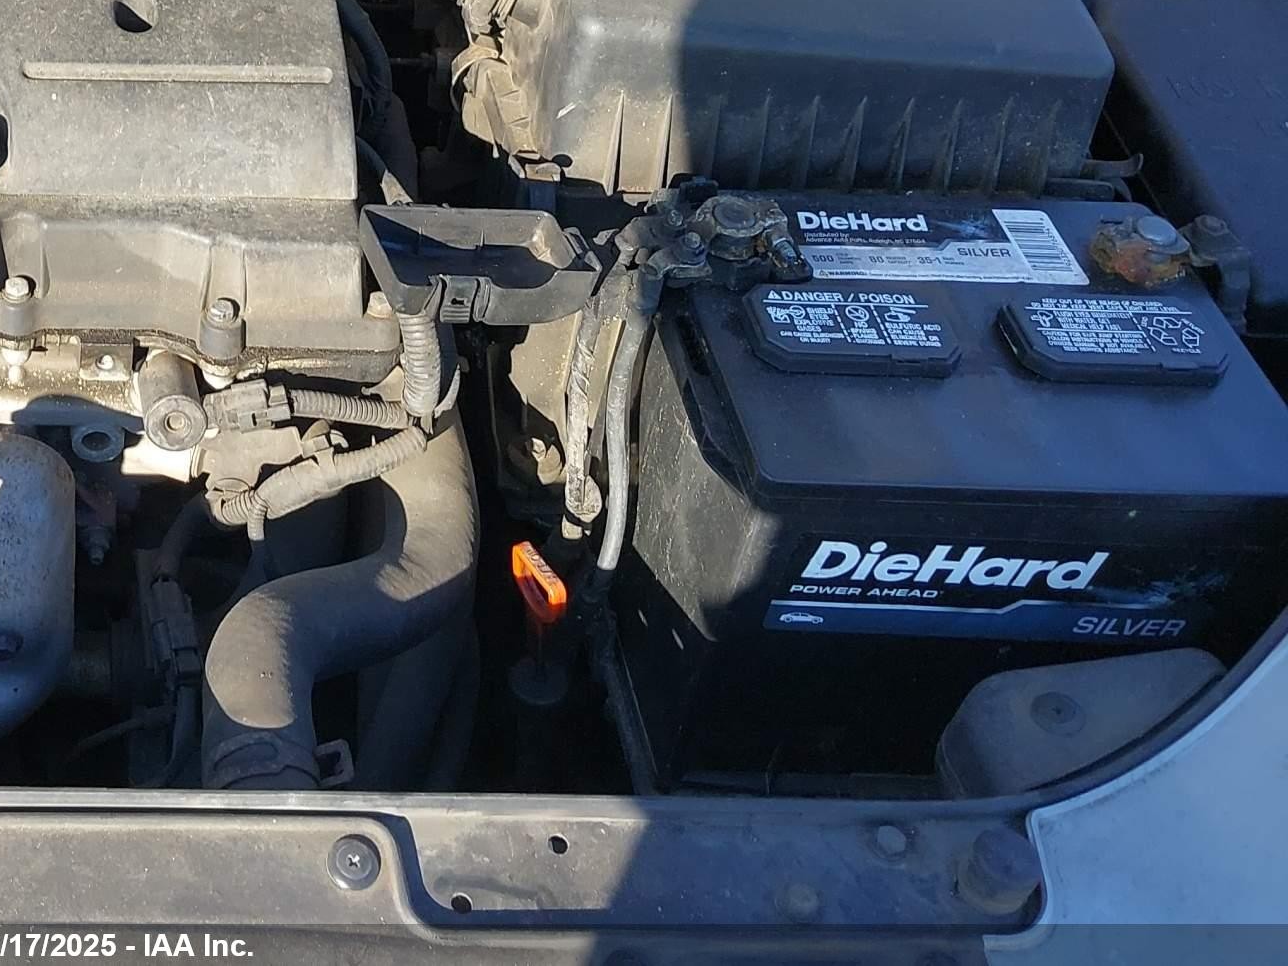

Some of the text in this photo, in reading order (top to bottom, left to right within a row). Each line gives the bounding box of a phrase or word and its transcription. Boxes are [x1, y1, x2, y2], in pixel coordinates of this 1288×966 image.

[797, 211, 929, 232] DieHard
[957, 247, 1011, 257] SILVER
[781, 291, 915, 305] DANGER / POISON
[885, 322, 921, 330] SULFURIC
[801, 539, 1110, 590] DieHard
[789, 584, 939, 599] POWER AHEAD
[1073, 616, 1186, 637] SILVER
